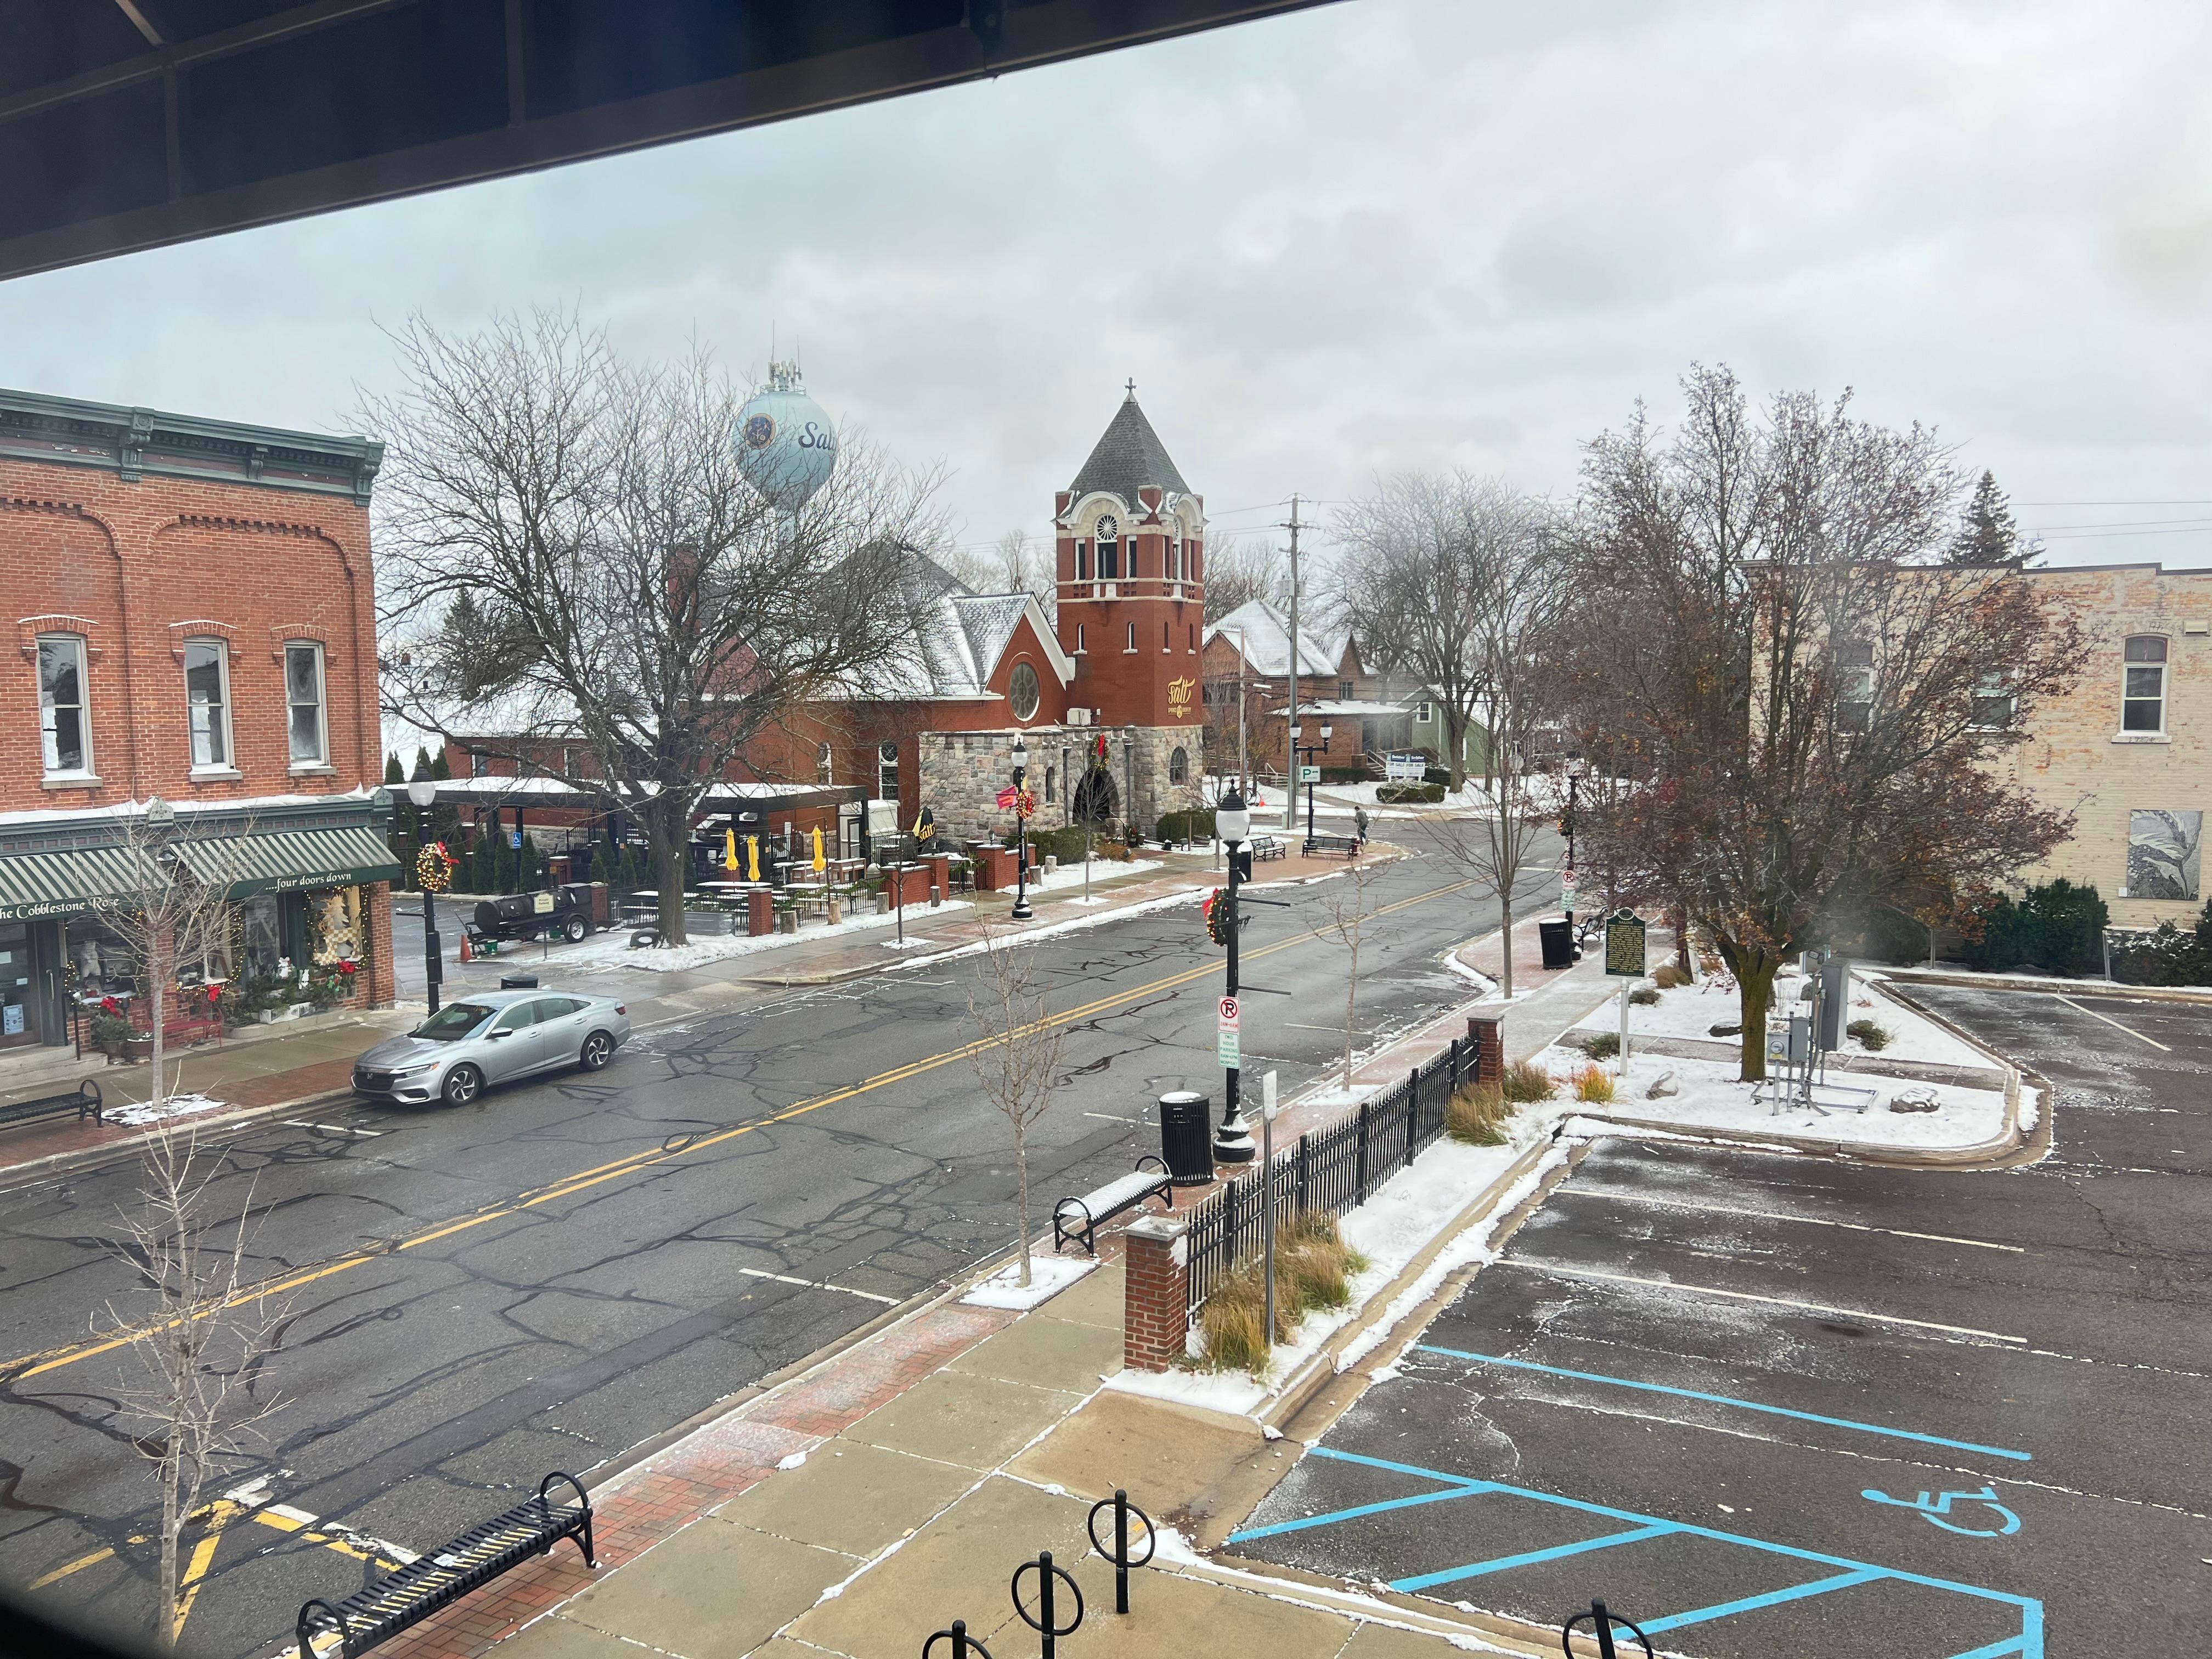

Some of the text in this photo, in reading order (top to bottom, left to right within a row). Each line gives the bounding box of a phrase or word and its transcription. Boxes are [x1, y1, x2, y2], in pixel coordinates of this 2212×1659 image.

[1304, 769, 1311, 779] P
[300, 875, 324, 885] doors
[326, 872, 351, 883] down
[0, 896, 120, 919] he Cobblestone Rose
[1225, 1002, 1234, 1015] P
